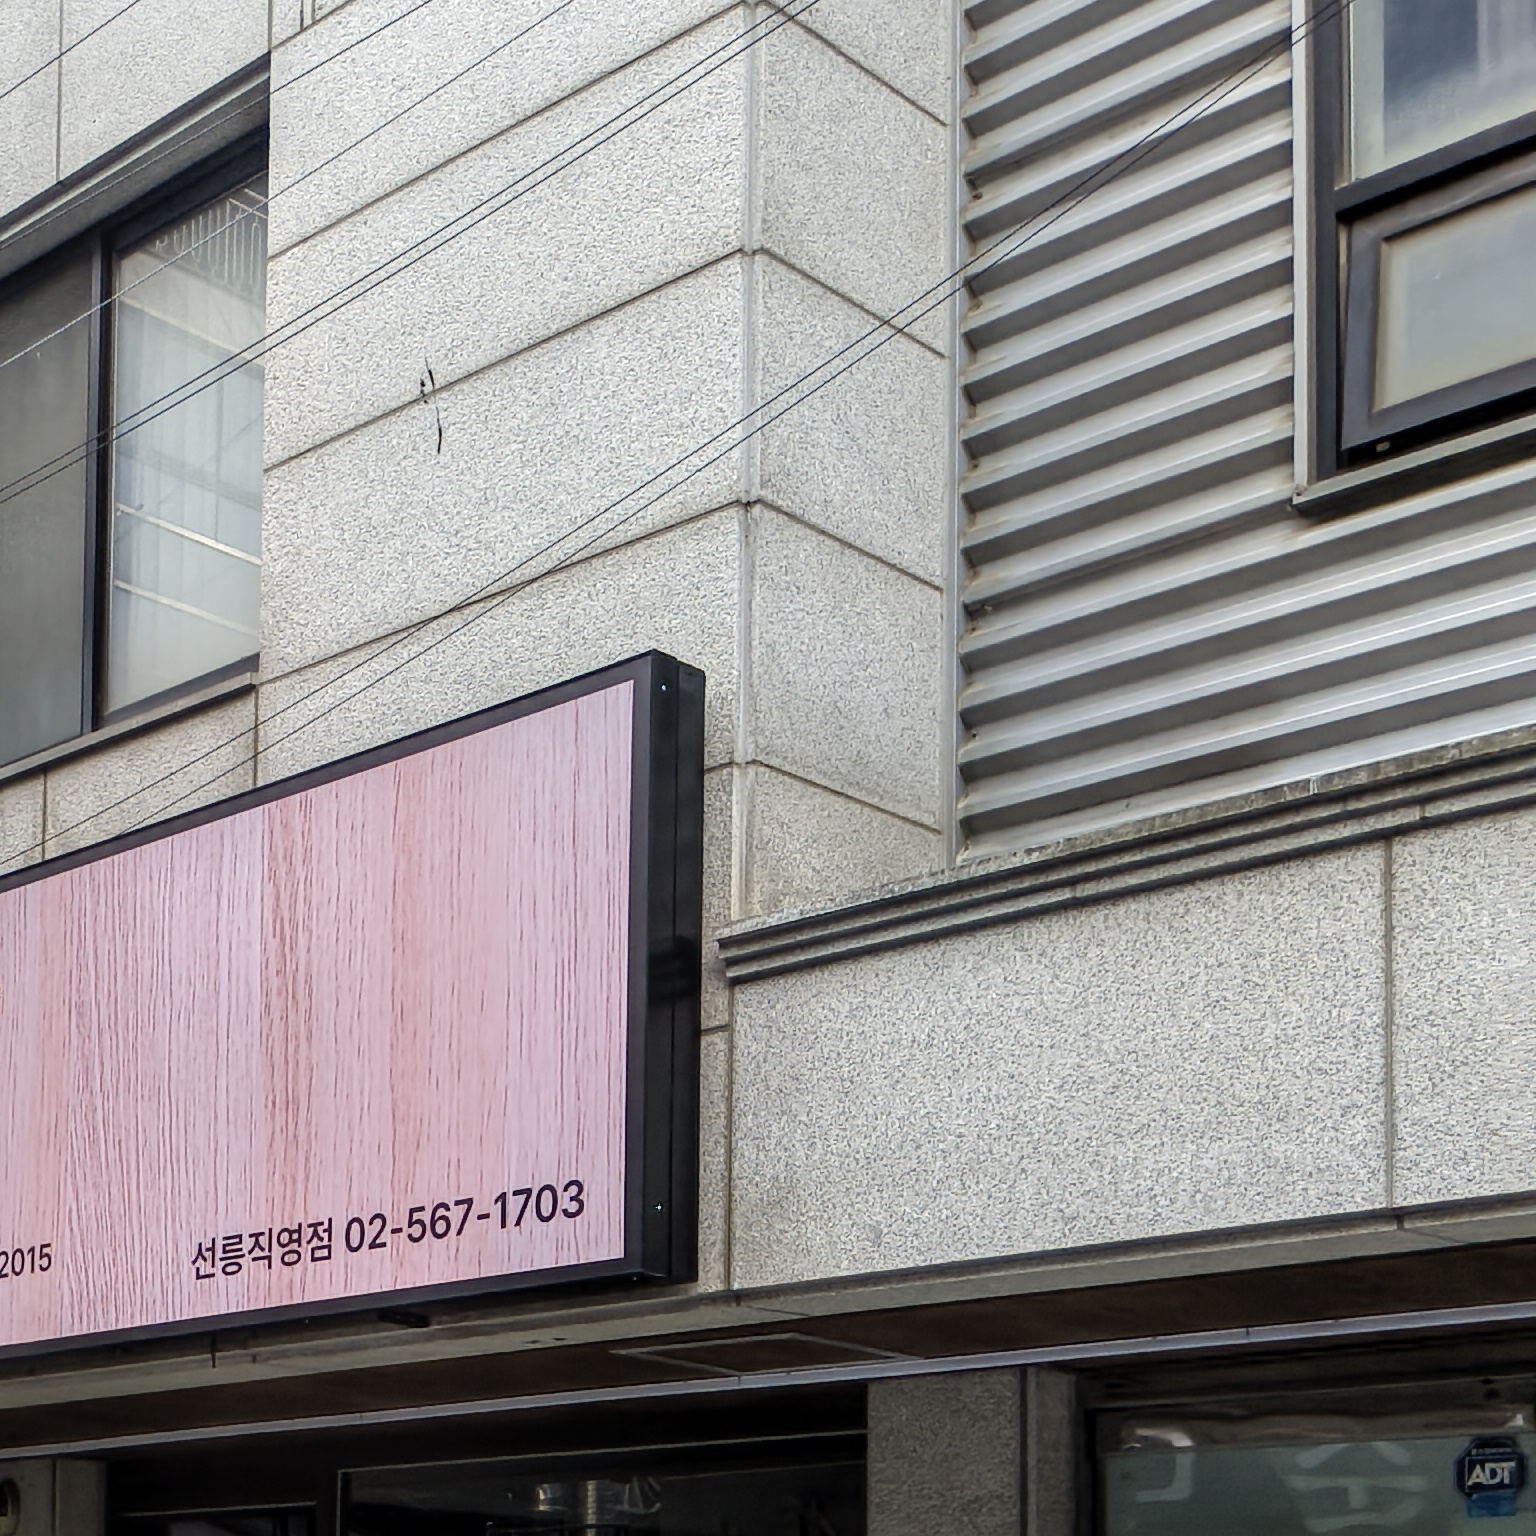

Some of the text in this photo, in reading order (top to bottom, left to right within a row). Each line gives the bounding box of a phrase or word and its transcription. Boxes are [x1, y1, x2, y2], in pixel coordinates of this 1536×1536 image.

[191, 1178, 586, 1281] 선릉직영점 02-567-1703
[1466, 1460, 1517, 1486] ADT
